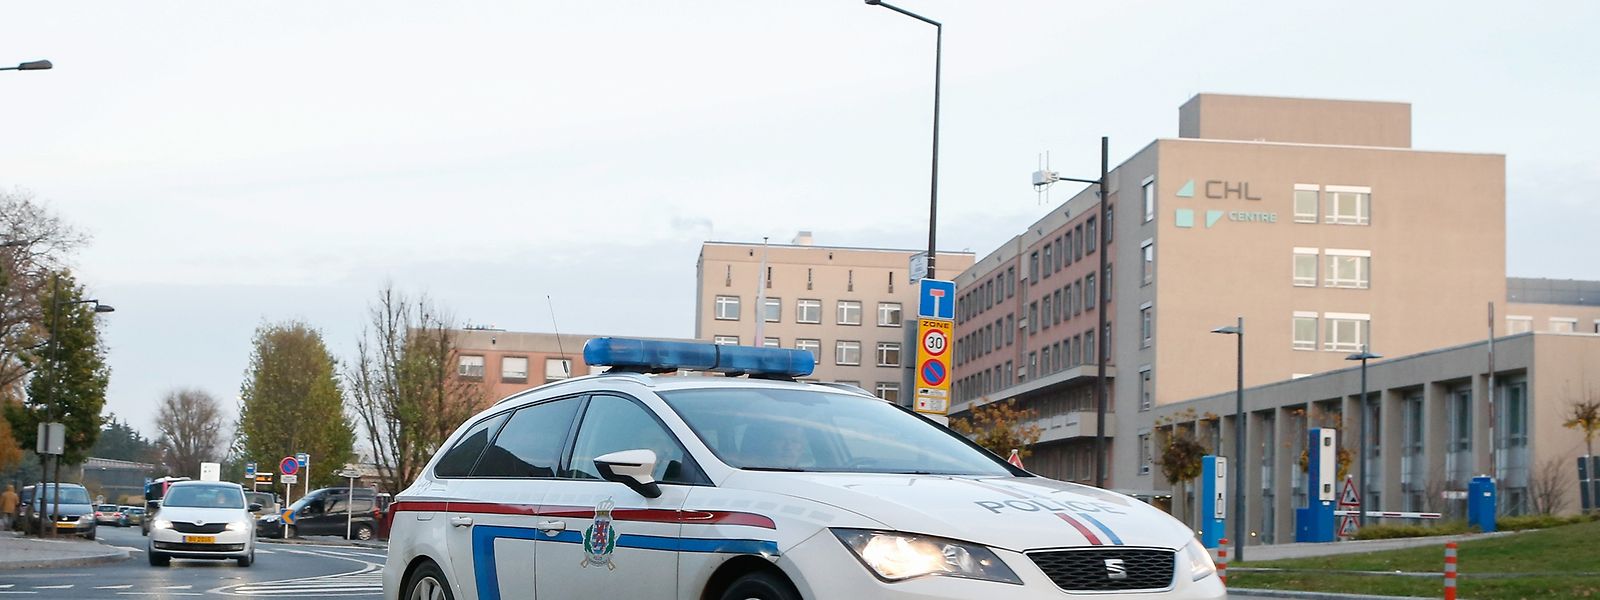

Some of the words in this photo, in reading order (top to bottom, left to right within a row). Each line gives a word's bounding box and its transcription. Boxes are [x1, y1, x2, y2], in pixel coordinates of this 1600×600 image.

[1205, 180, 1262, 201] CHL
[1228, 210, 1277, 223] CENTRE
[922, 320, 950, 329] ZONE
[928, 336, 943, 349] 30
[974, 499, 1127, 515] POLICE
